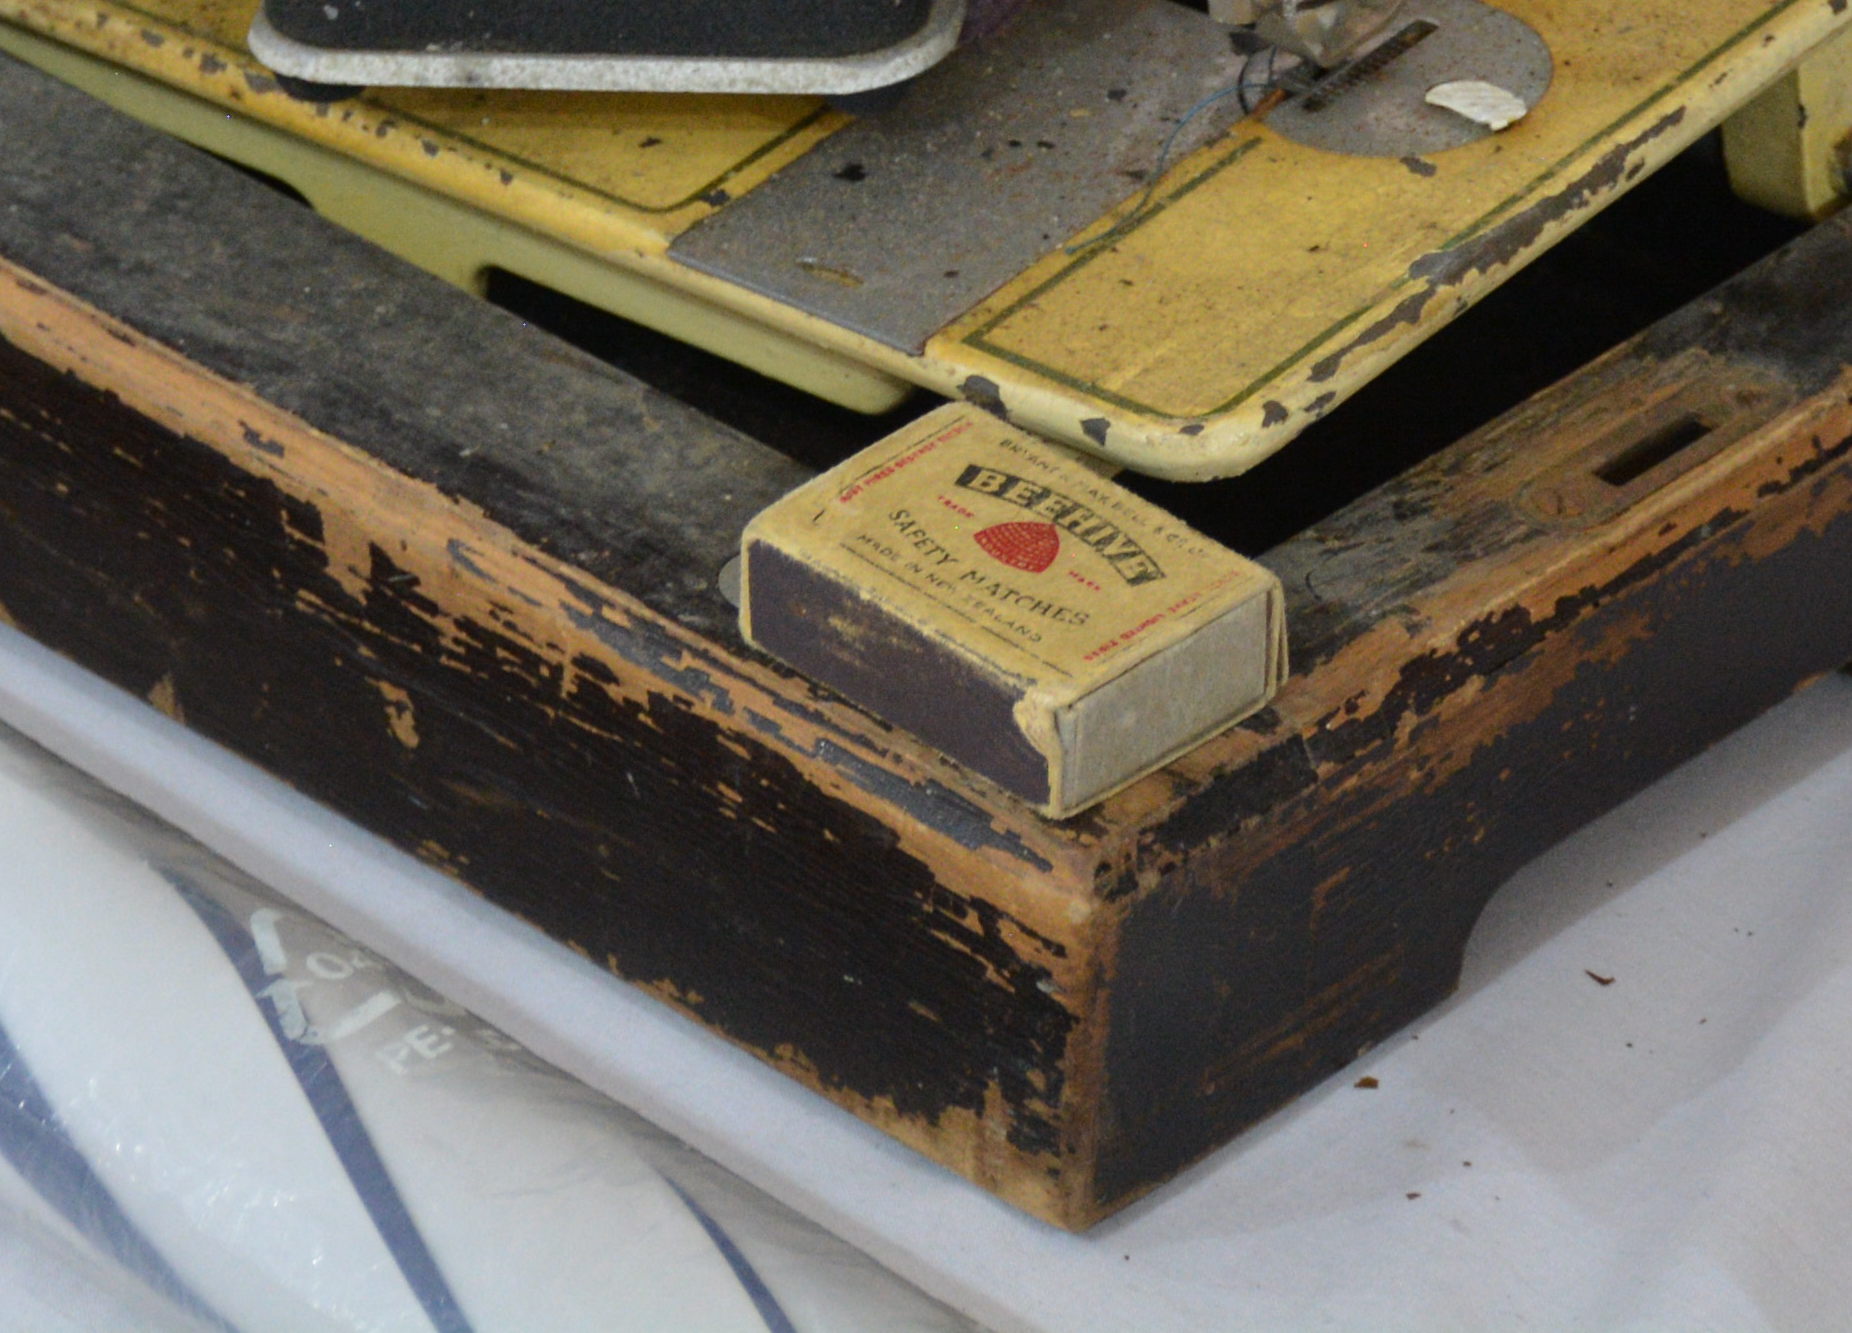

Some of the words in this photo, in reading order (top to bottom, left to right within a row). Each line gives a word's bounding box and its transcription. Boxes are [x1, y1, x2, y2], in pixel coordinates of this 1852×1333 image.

[855, 533, 898, 560] MADE
[888, 508, 960, 566] SAFETY
[960, 569, 1091, 627] MATCHES
[957, 465, 1162, 585] BEEHIVE
